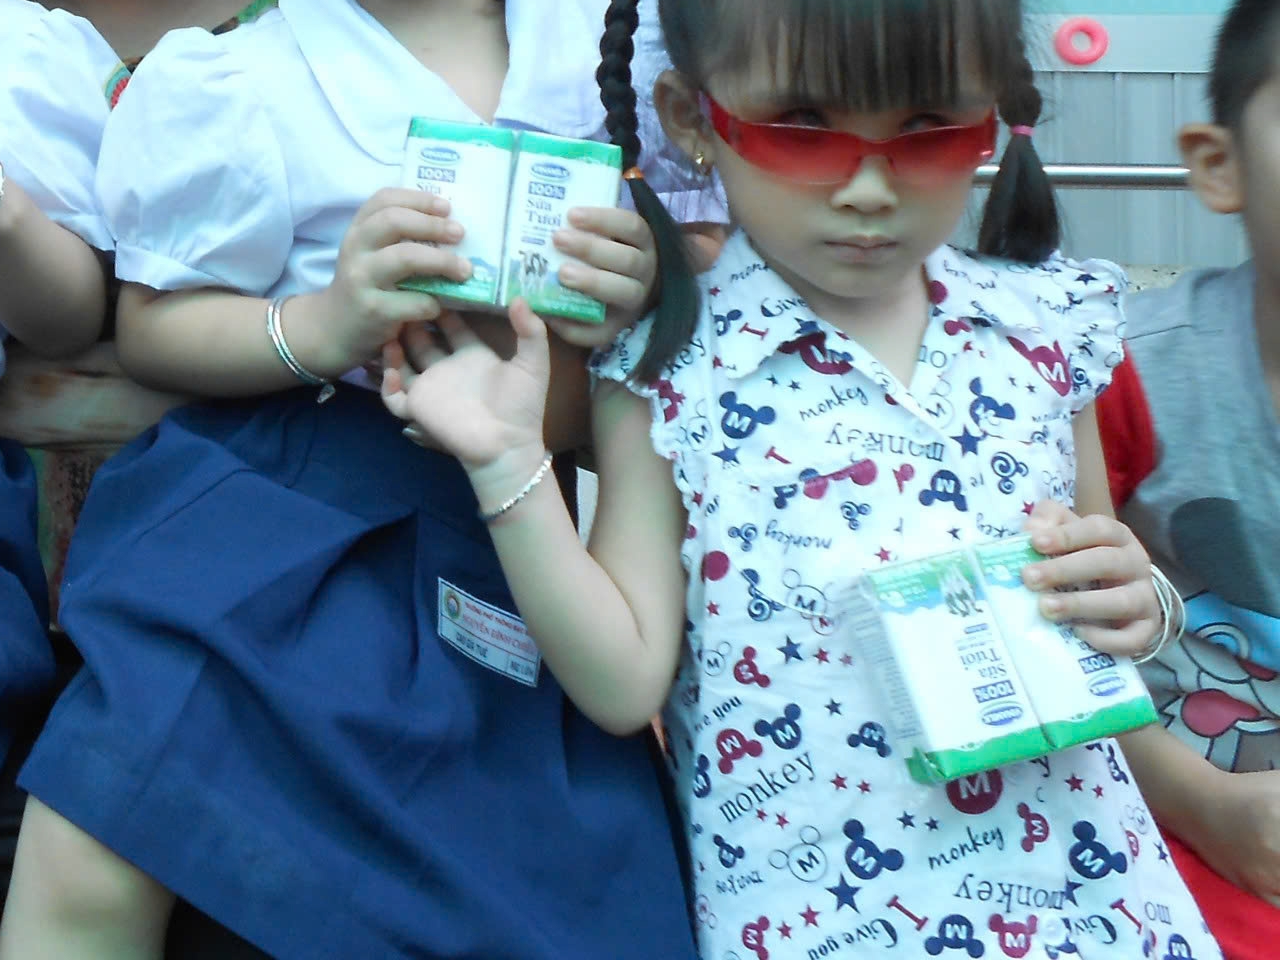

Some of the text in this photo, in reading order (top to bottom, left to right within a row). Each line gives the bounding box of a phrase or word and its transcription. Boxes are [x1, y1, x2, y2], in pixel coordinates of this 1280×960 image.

[798, 384, 870, 422] monkey
[718, 751, 817, 824] monkey
[928, 826, 1005, 870] monkey
[952, 873, 1067, 913] monkey
